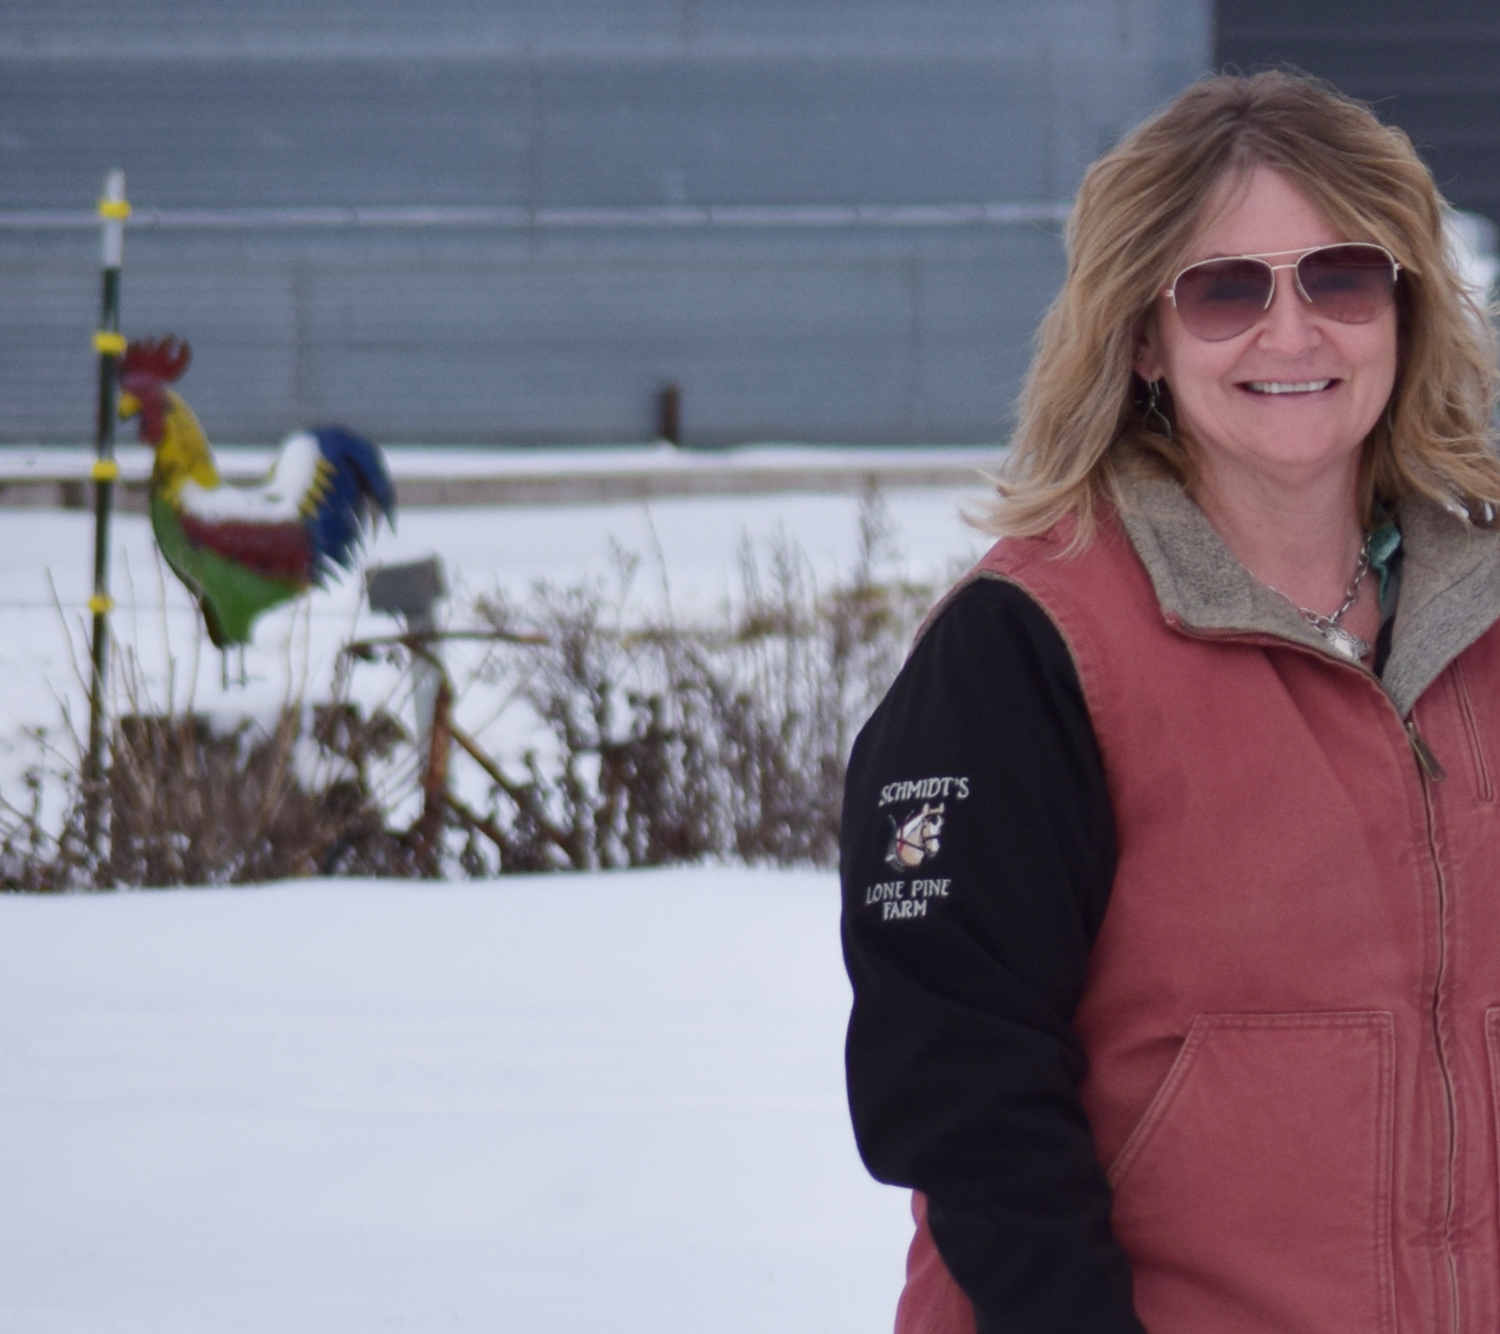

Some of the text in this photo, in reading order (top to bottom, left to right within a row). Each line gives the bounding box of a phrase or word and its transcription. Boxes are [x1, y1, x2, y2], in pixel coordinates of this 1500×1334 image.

[878, 777, 970, 808] SCHMIDT'S
[866, 878, 952, 906] LONE PINE
[882, 898, 928, 922] FARM
